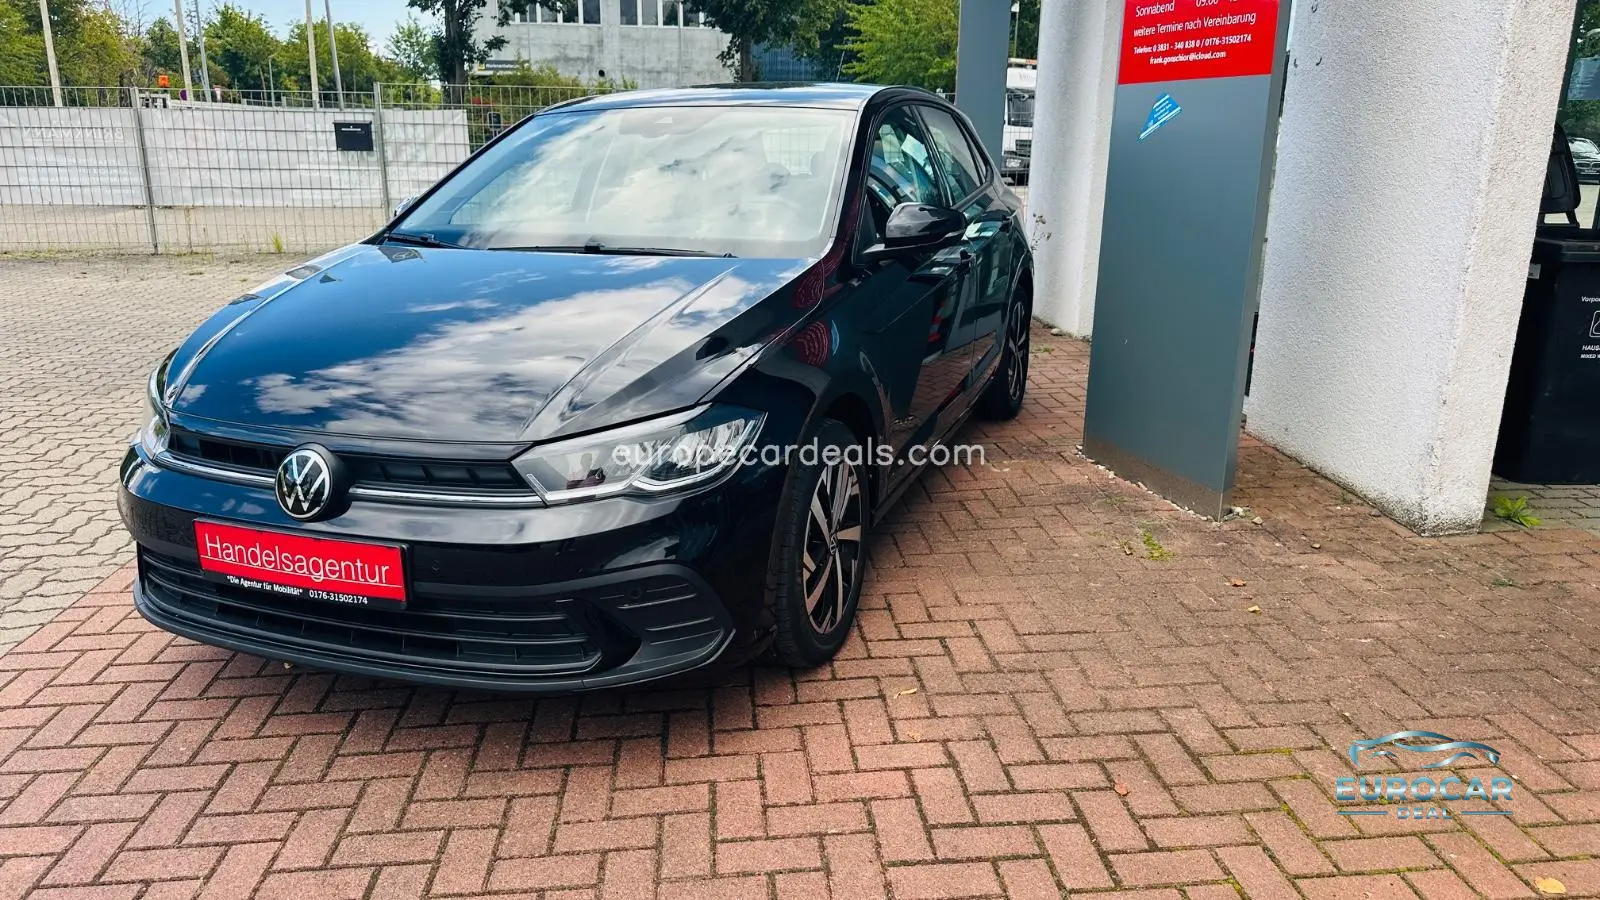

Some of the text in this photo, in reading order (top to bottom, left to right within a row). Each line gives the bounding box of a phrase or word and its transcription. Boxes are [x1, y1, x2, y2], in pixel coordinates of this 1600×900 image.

[1135, 1, 1175, 17] Sonnabend
[1133, 12, 1256, 37] weitere Termine nach Vereinbarung
[1204, 33, 1252, 47] 0176-31502174
[1581, 296, 1600, 304] Vorpo
[204, 532, 390, 583] Handelsagentur
[240, 578, 262, 588] Agentur
[263, 581, 272, 590] für
[309, 589, 368, 605] 0176-31502174
